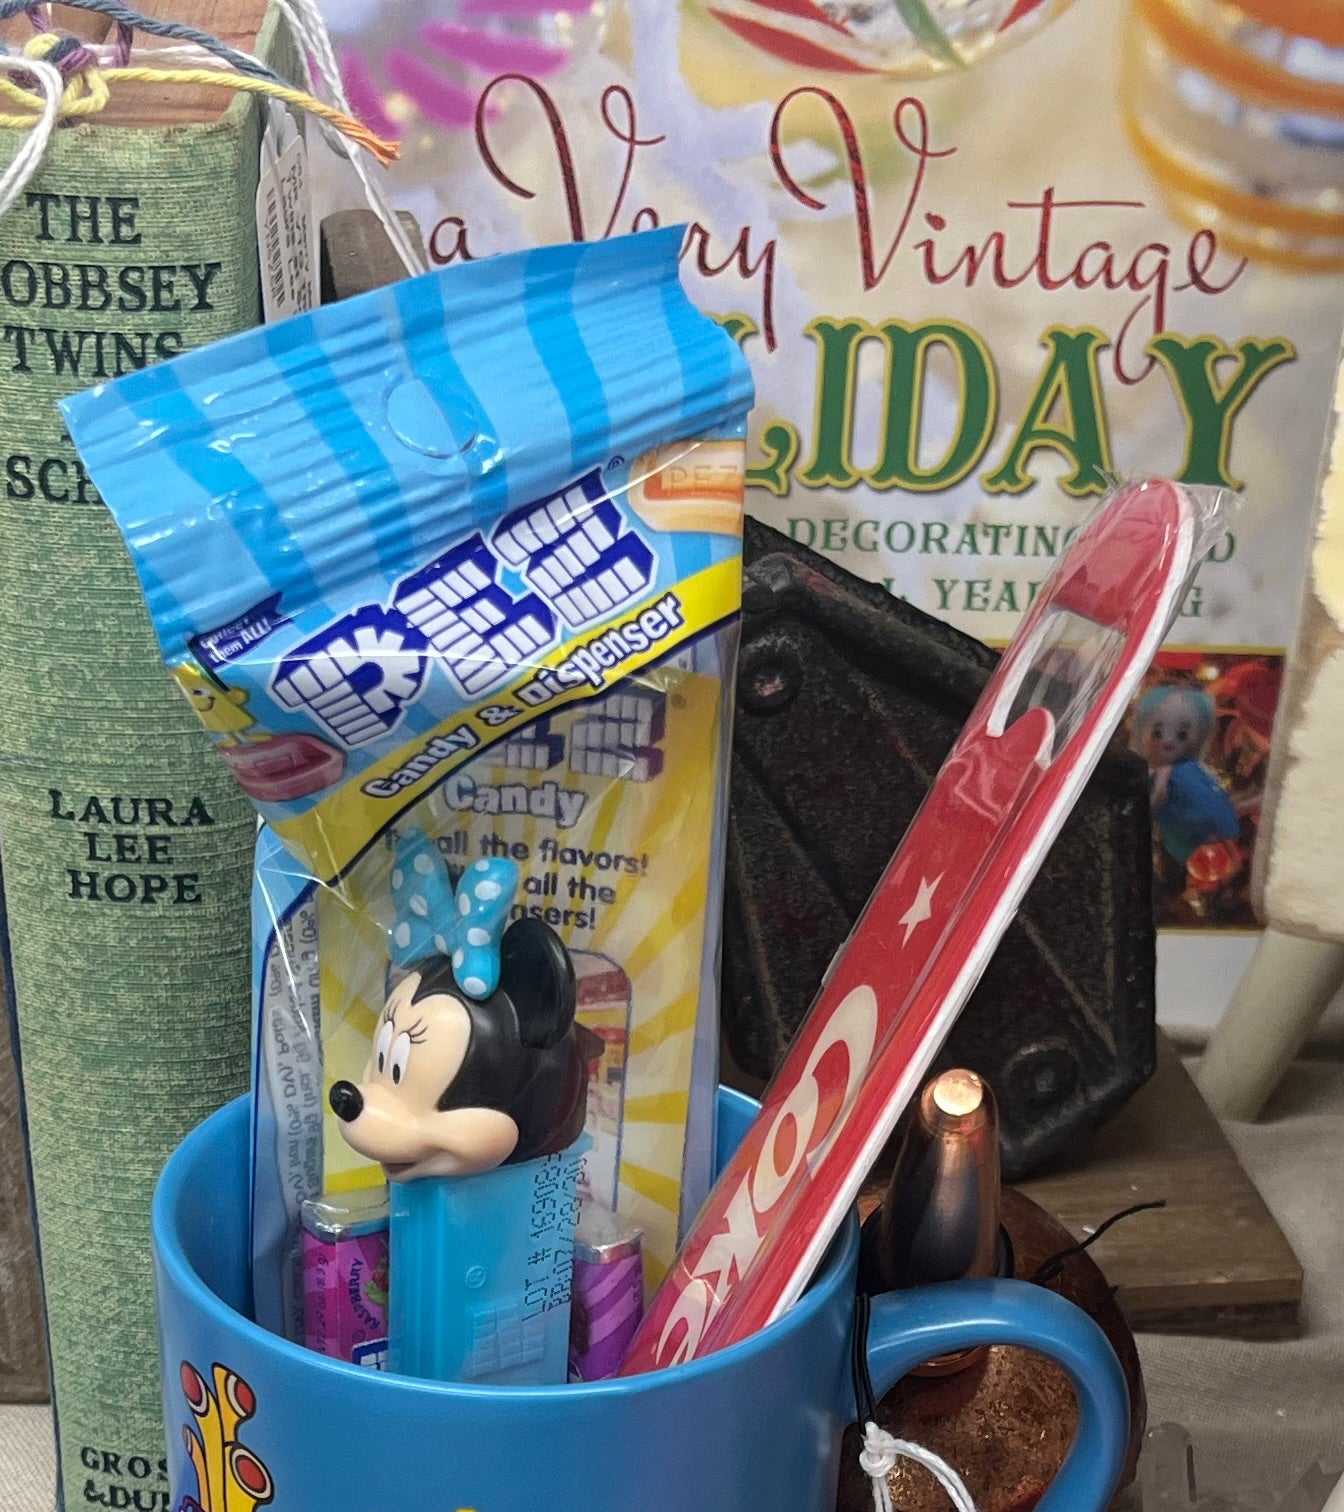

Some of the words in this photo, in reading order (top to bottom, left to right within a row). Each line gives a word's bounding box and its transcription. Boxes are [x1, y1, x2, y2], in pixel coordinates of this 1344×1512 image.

[27, 192, 142, 246] THE
[427, 214, 472, 266] a
[768, 85, 1248, 386] Vintage
[2, 324, 184, 379] TWINS
[268, 462, 660, 750] PEZ
[363, 724, 479, 800] Candy
[479, 700, 521, 732] &
[516, 592, 683, 707] Dispenser
[47, 788, 216, 827] LAURA
[442, 771, 590, 829] Candy
[83, 831, 174, 865] LEE
[437, 830, 469, 855] all
[478, 831, 530, 861] the
[537, 838, 650, 877] flavors!
[67, 868, 203, 905] HOPE
[522, 870, 558, 897] all
[567, 876, 617, 906] the
[654, 984, 879, 1368] Coke
[347, 1256, 382, 1332] RASPBERRY
